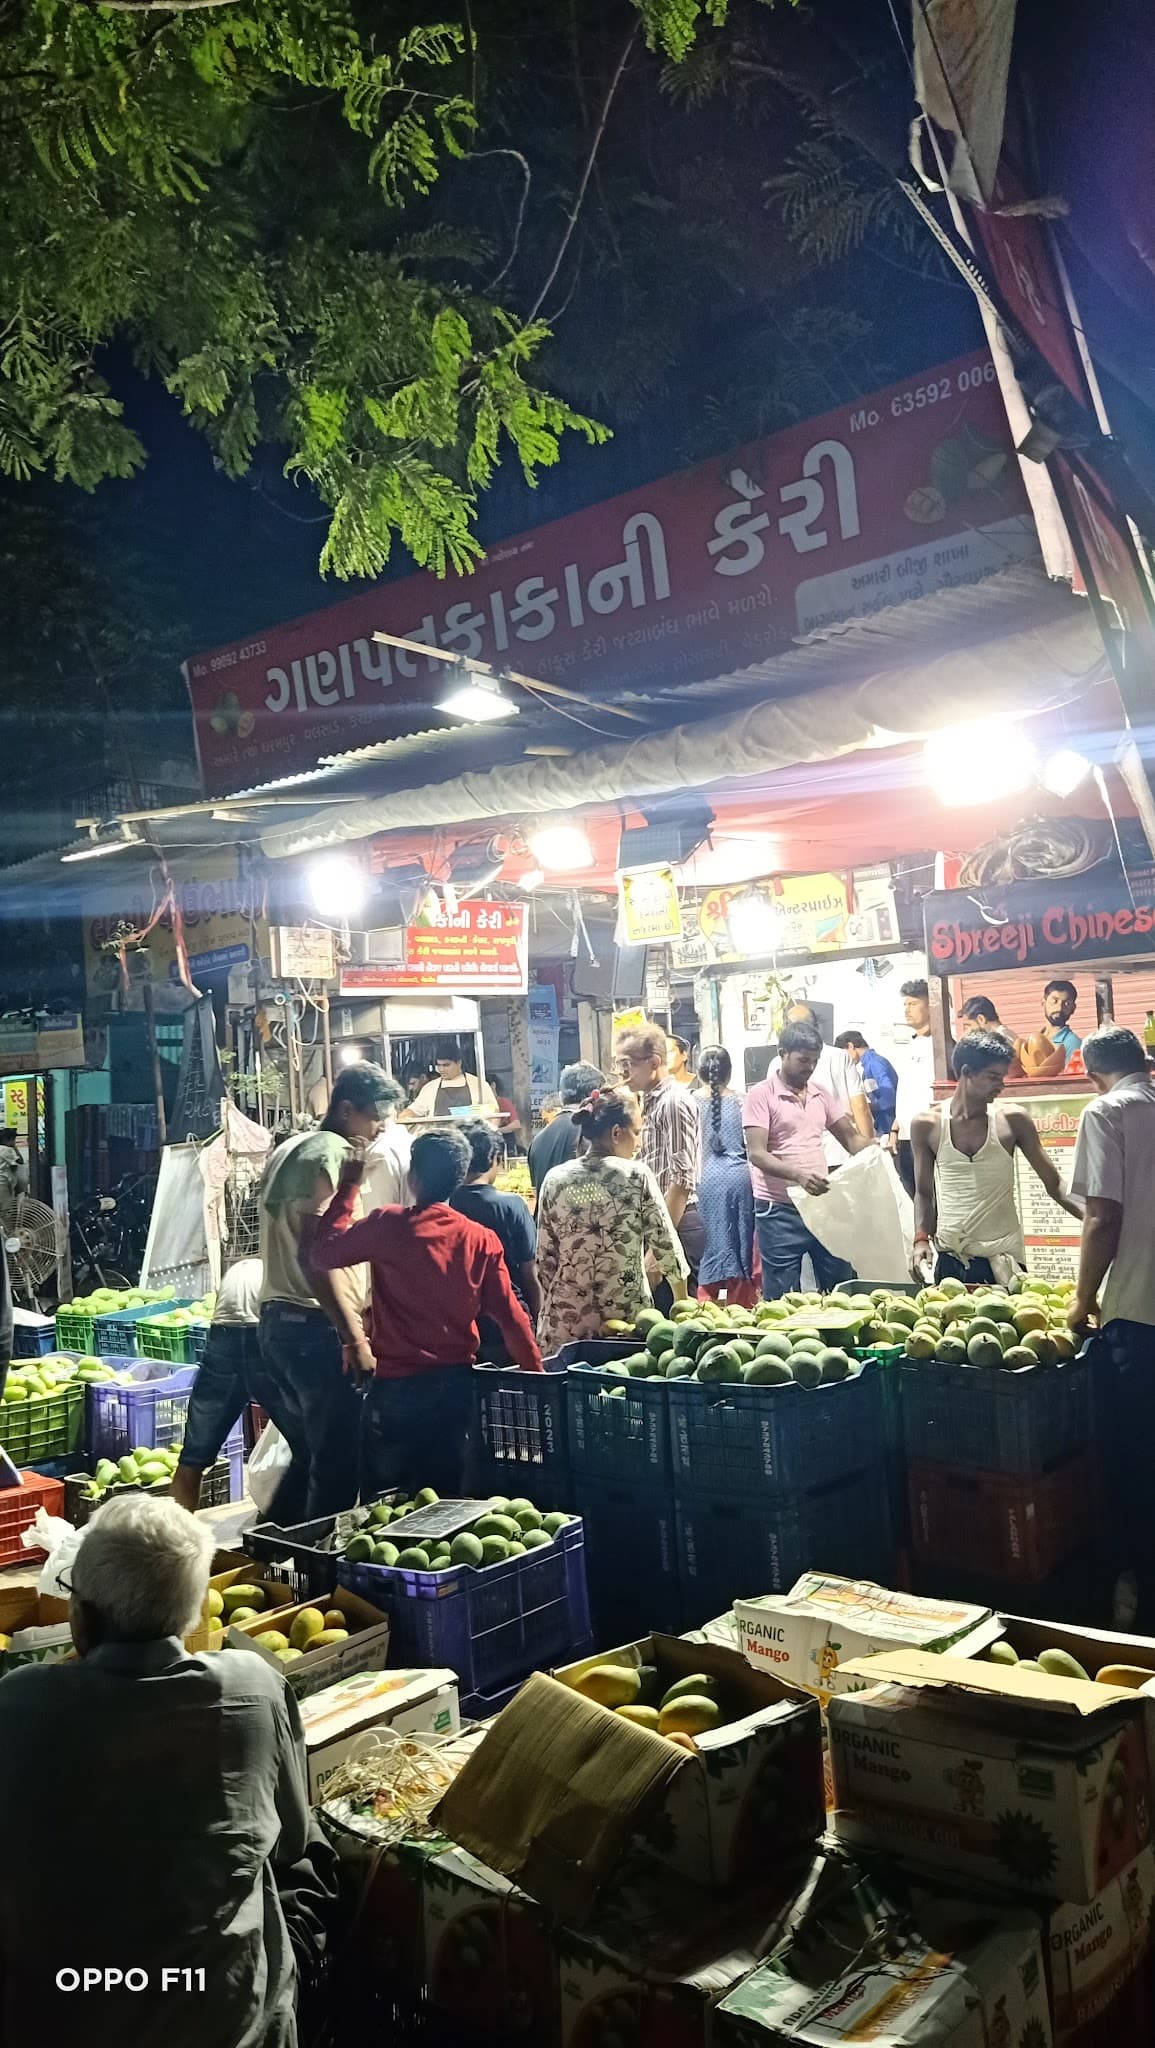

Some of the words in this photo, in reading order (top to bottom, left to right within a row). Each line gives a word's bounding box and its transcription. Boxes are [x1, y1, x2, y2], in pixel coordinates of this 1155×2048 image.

[890, 379, 953, 417] 63592
[265, 511, 671, 713] ગણપતકાકાની
[706, 439, 861, 577] કેરી
[476, 909, 502, 929] કેરી
[932, 912, 1036, 964] Shreeji
[1042, 904, 1155, 949] Chines
[543, 1403, 555, 1453] 2023
[739, 1619, 785, 1643] RGANIC
[746, 1638, 790, 1663] Mango
[832, 1727, 900, 1759] ORGANIC
[853, 1753, 912, 1784] Mango
[1050, 1902, 1104, 1950] ORGANIC
[1074, 1925, 1112, 1965] Mango
